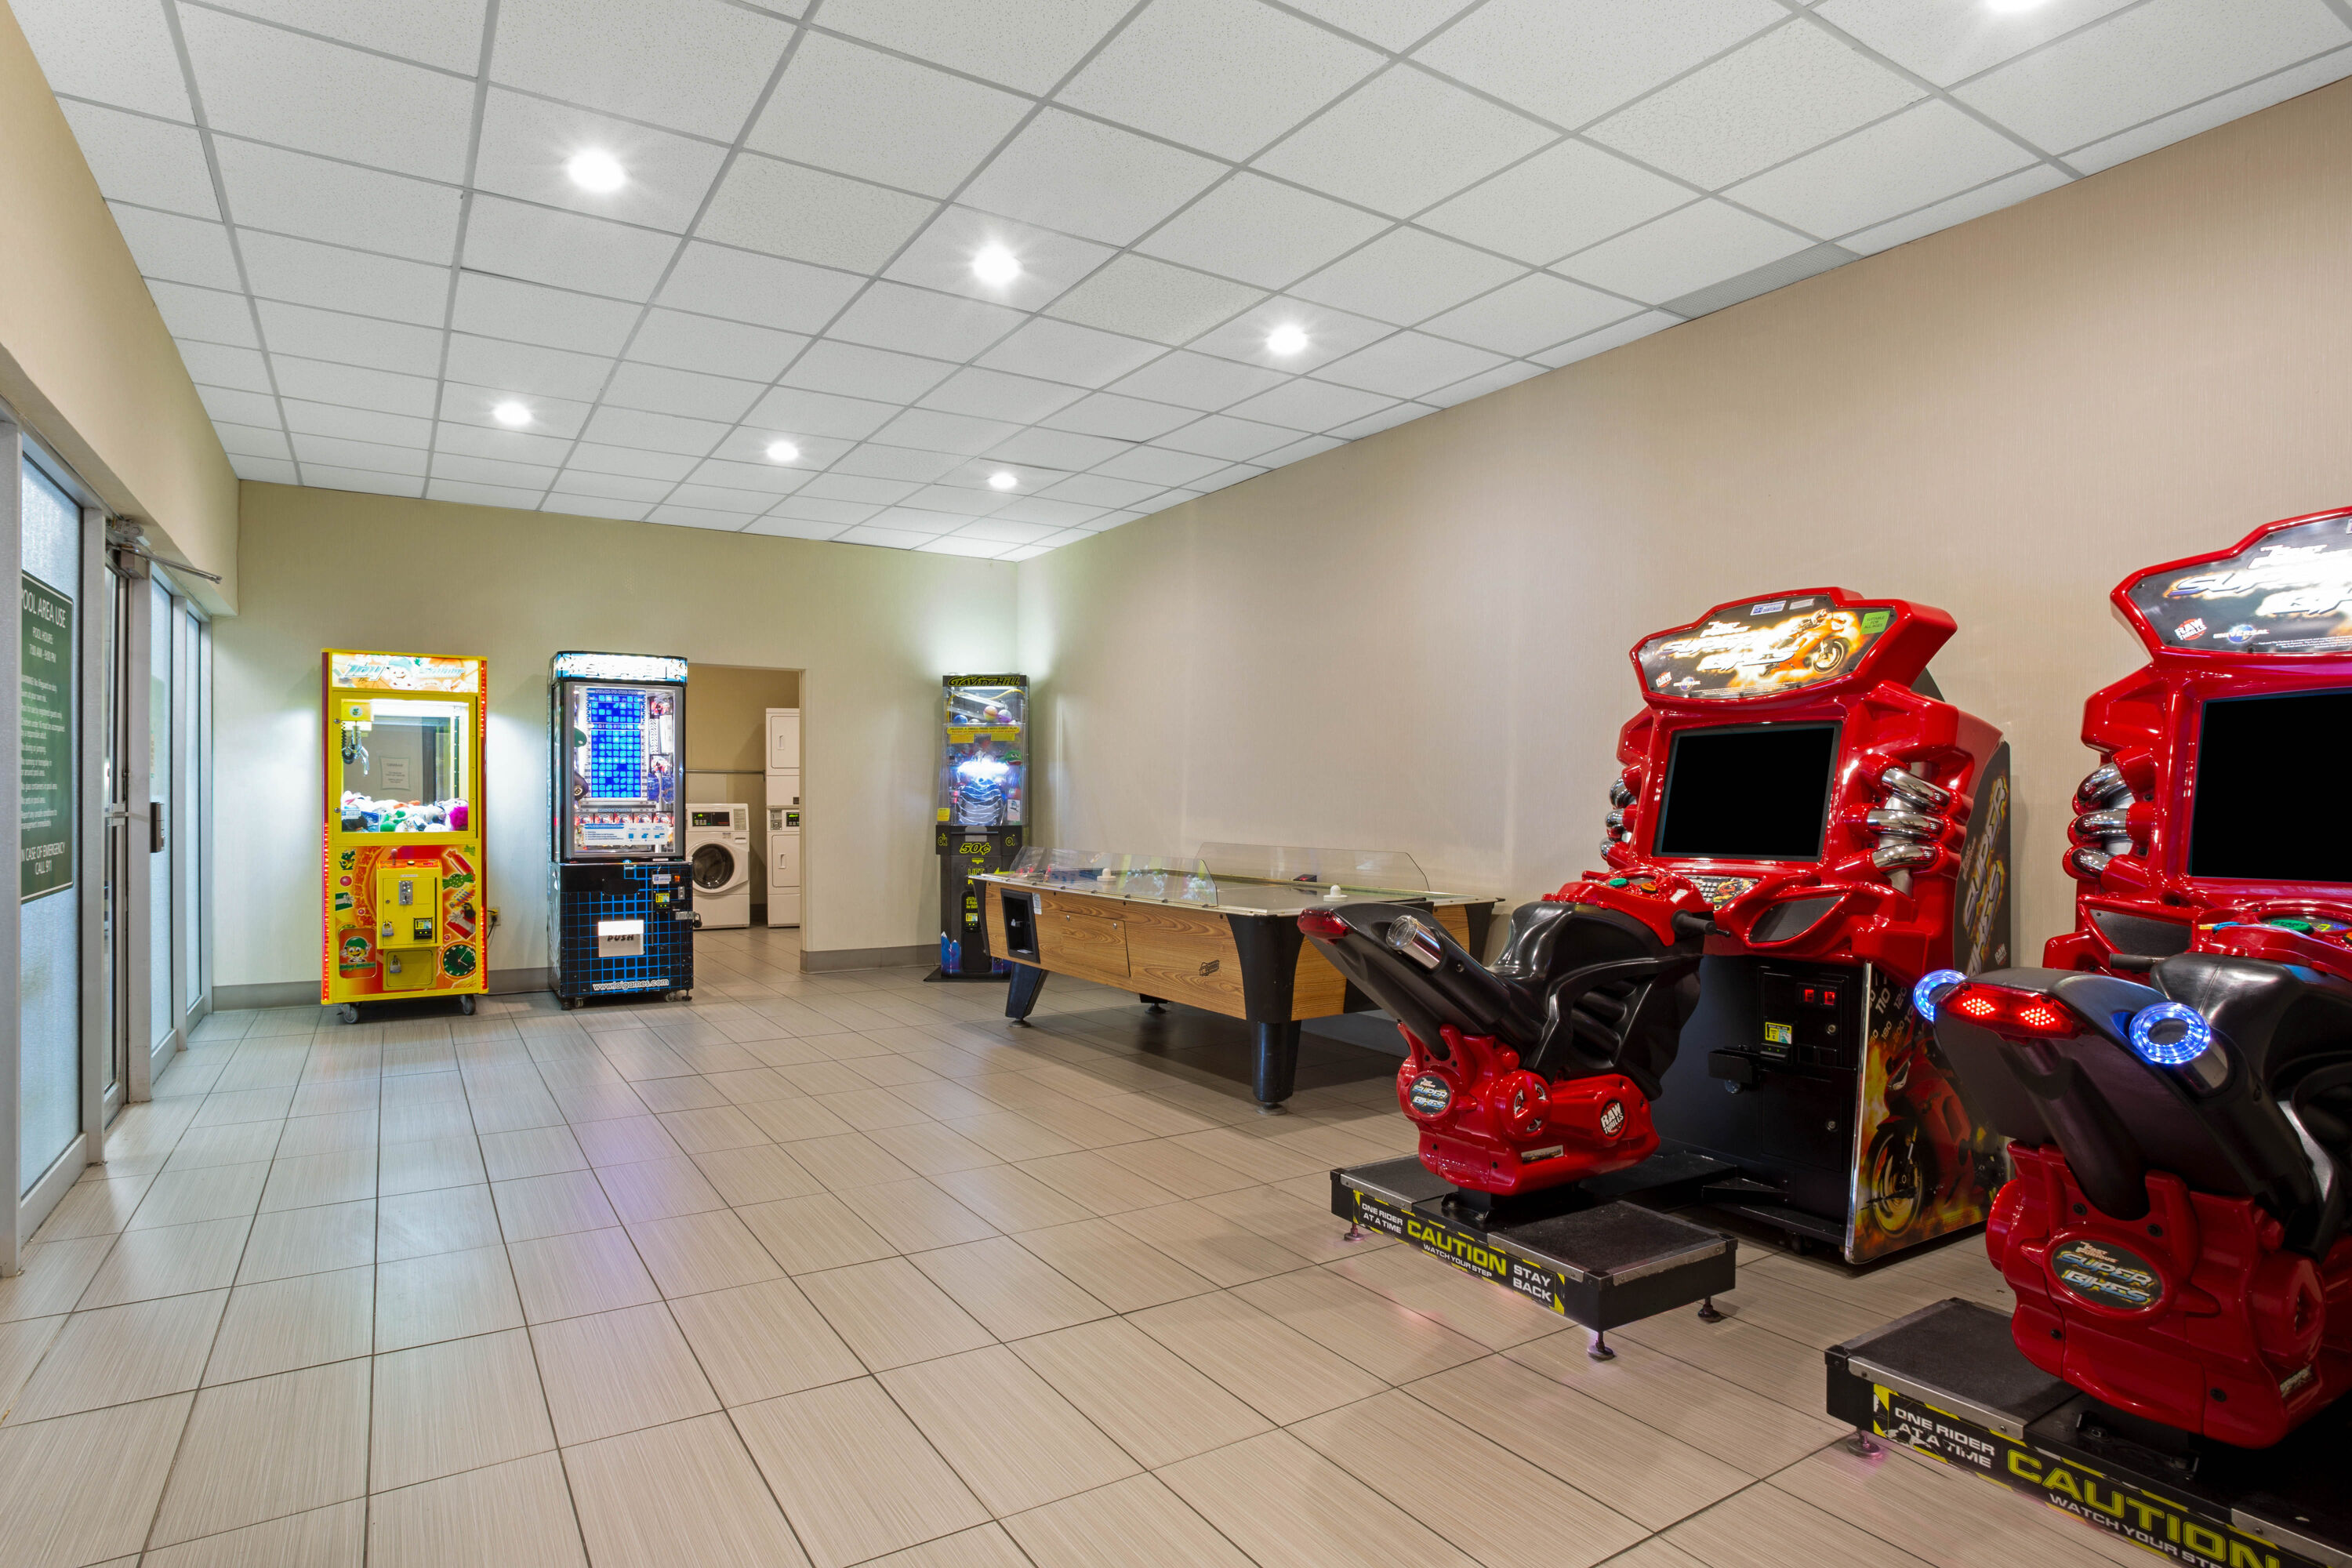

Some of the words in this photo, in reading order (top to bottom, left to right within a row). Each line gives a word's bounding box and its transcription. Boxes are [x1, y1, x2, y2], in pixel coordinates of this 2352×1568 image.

[21, 589, 37, 614] OOL
[38, 597, 54, 622] AREA
[55, 606, 66, 628] USE
[2174, 618, 2207, 636] RAW
[26, 847, 36, 861] CASE
[37, 845, 43, 859] OF
[43, 841, 66, 857] EMERGENCY
[1964, 777, 2006, 937] SUPER
[35, 861, 45, 875] CALL
[607, 934, 634, 942] PUSH
[1875, 988, 1890, 1014] 110
[1413, 1084, 1449, 1098] SUPER
[1414, 1096, 1446, 1109] BIKES
[1600, 1102, 1621, 1128] RAW
[1604, 1113, 1624, 1134] THRILLS
[1362, 1202, 1378, 1215] ONE
[1378, 1209, 1403, 1225] RIDER
[1363, 1212, 1374, 1222] AT
[1374, 1217, 1381, 1225] A
[1381, 1219, 1402, 1235] TIME
[1407, 1219, 1507, 1276] CAUTION
[1423, 1243, 1450, 1260] WATCH
[1450, 1254, 1472, 1270] YOUR
[1472, 1265, 1492, 1278] STEP
[1513, 1264, 1552, 1287] STAY
[2057, 1252, 2153, 1287] SUPER
[1512, 1276, 1552, 1301] BACK
[2063, 1270, 2151, 1302] BIKES
[1894, 1407, 1933, 1431] ONE
[1936, 1423, 1995, 1457] RIDER
[1898, 1423, 1923, 1438] AT
[1926, 1435, 1941, 1447] A
[1943, 1439, 1992, 1468] TIME
[2007, 1449, 2279, 1568] CAUTION
[2049, 1493, 2120, 1530] WATCH
[2122, 1526, 2178, 1556] YOUR
[2180, 1549, 2223, 1568] STE
